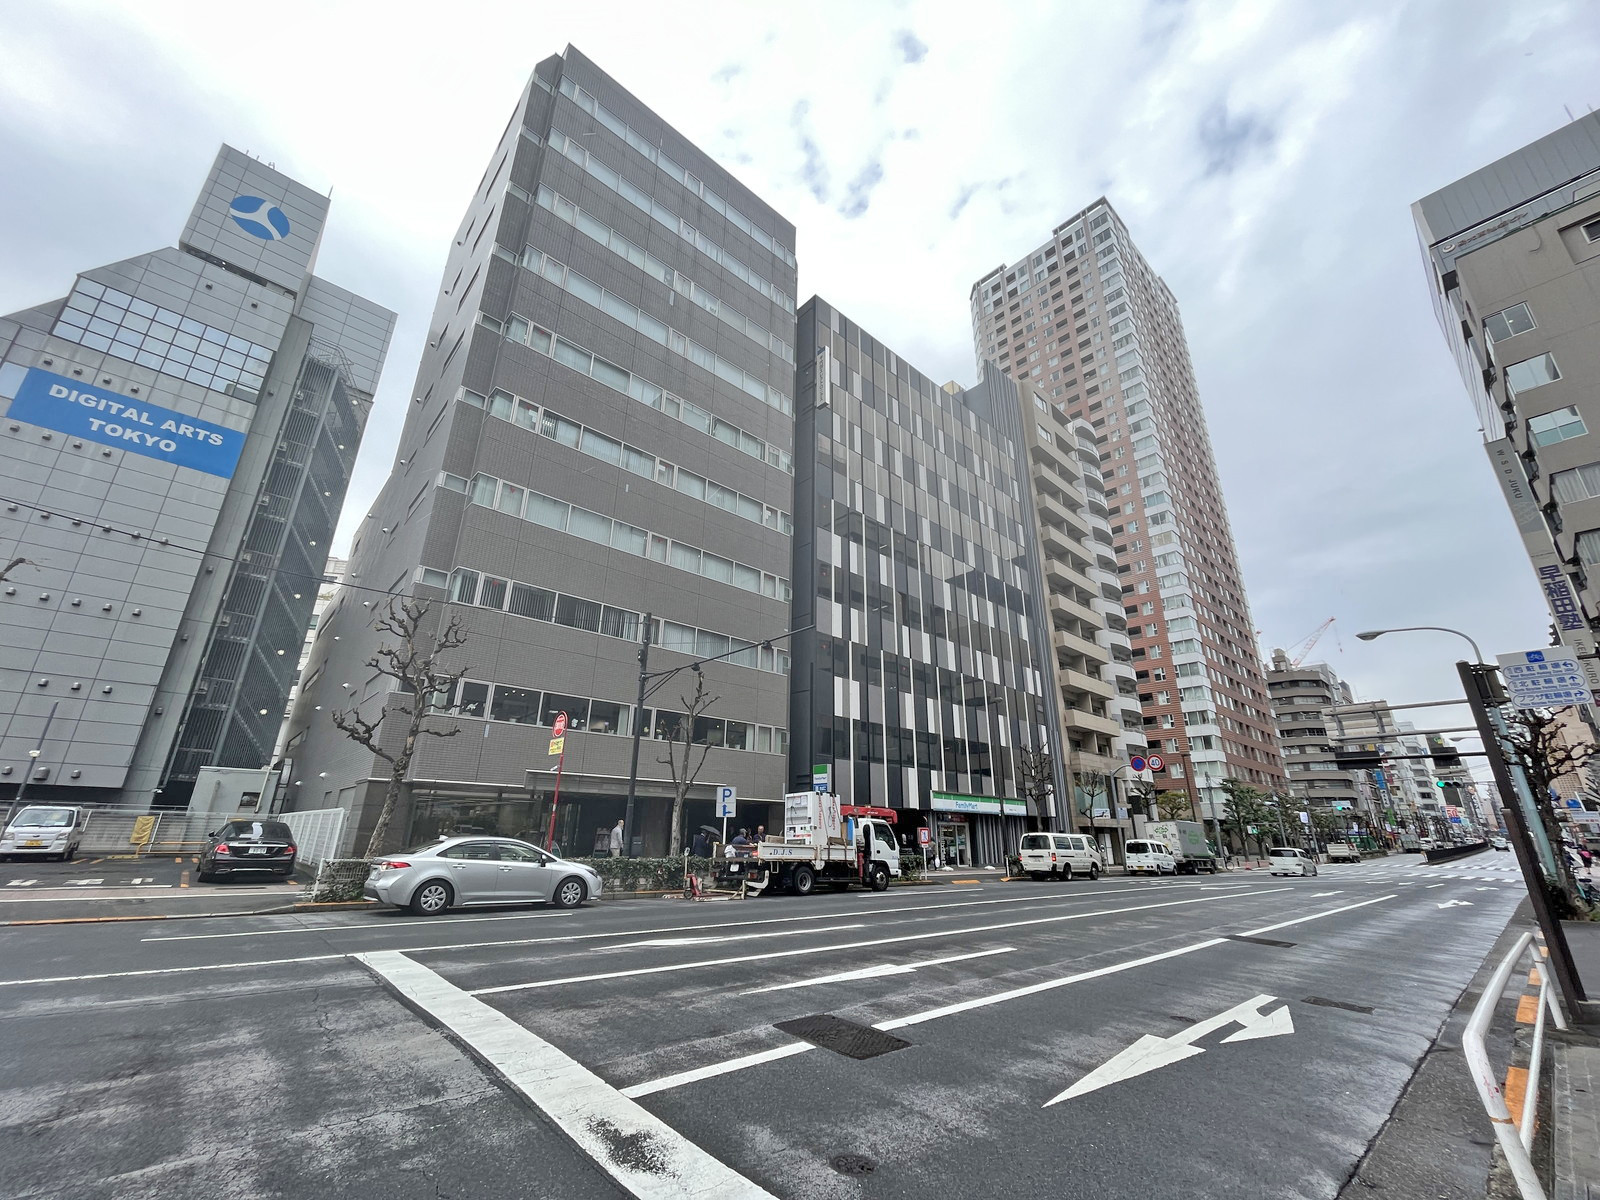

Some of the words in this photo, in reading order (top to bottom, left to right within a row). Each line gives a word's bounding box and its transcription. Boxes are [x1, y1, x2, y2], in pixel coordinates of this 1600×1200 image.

[48, 384, 154, 426] DIGITAL
[160, 420, 224, 446] ARTS
[89, 418, 177, 452] TOKYO
[1538, 565, 1584, 631] 早稲田塾
[722, 788, 732, 802] P
[955, 801, 978, 810] FamilyMart
